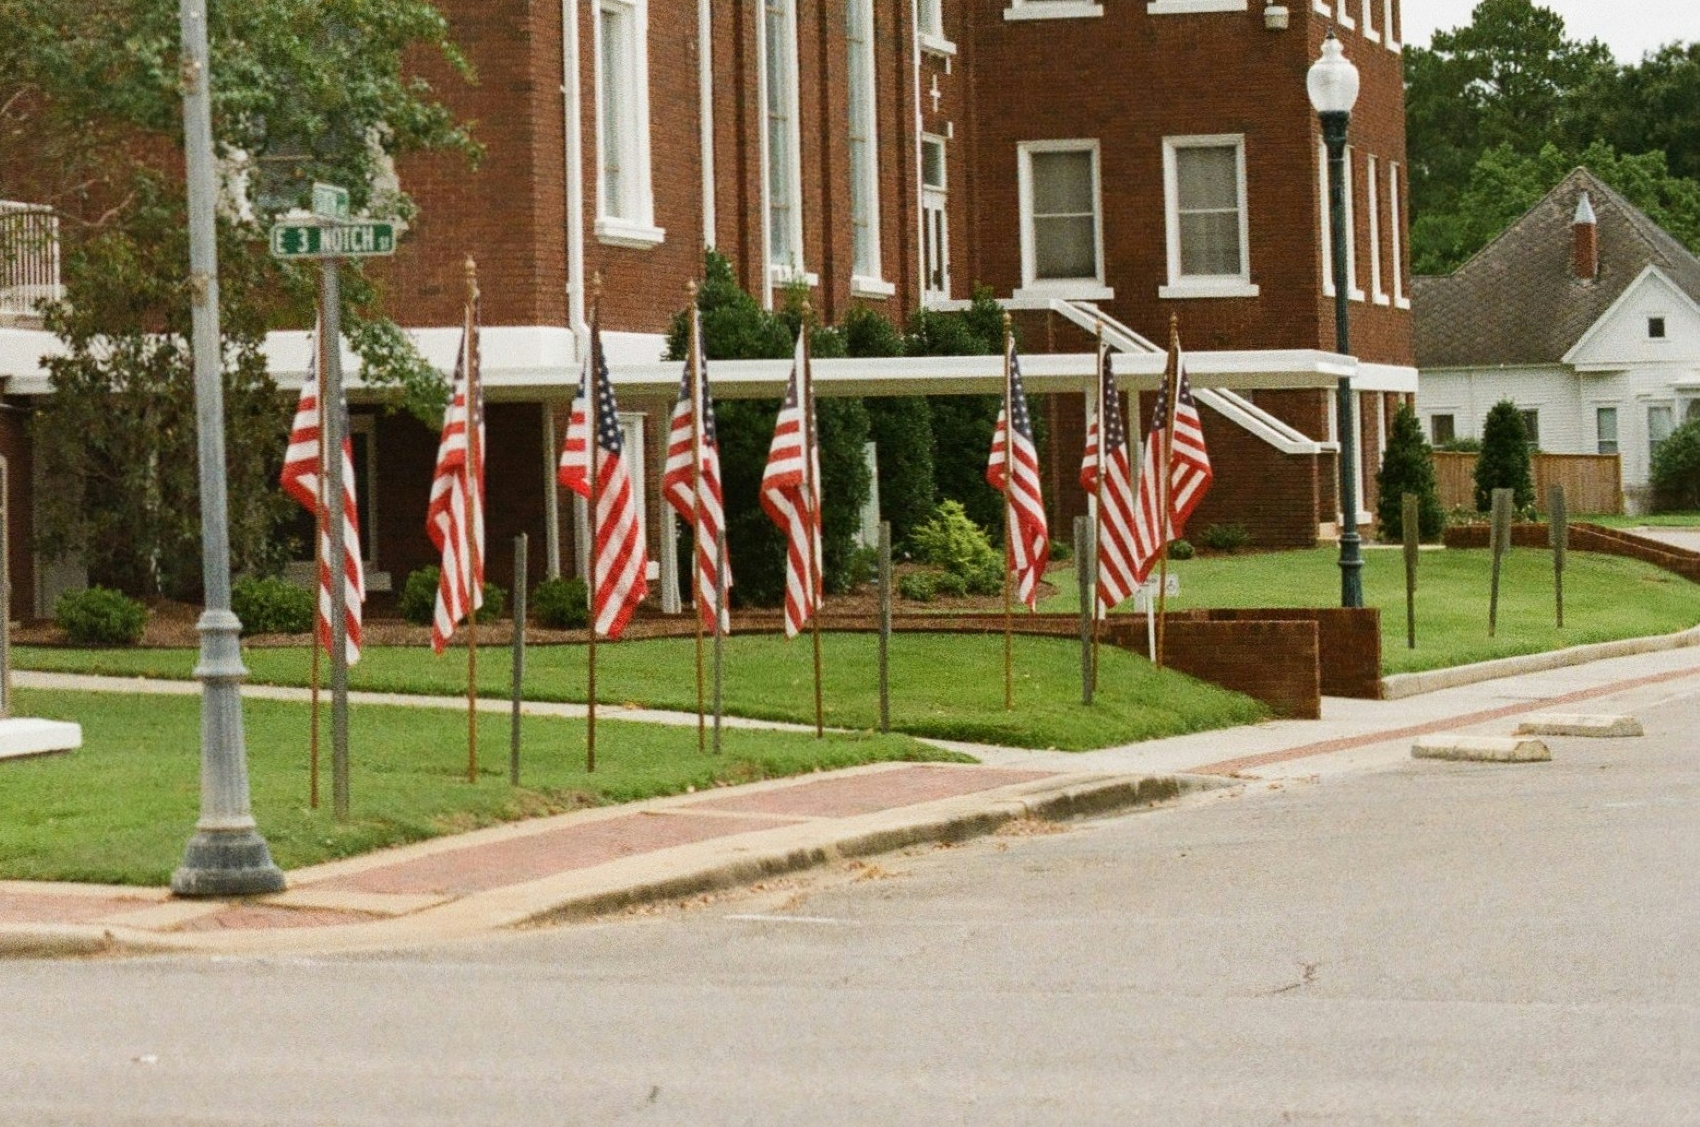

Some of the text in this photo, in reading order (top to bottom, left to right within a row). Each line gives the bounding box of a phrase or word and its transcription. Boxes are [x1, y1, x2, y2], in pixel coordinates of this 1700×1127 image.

[276, 228, 287, 253] E
[297, 228, 309, 253] 3
[320, 226, 374, 252] NOTCH
